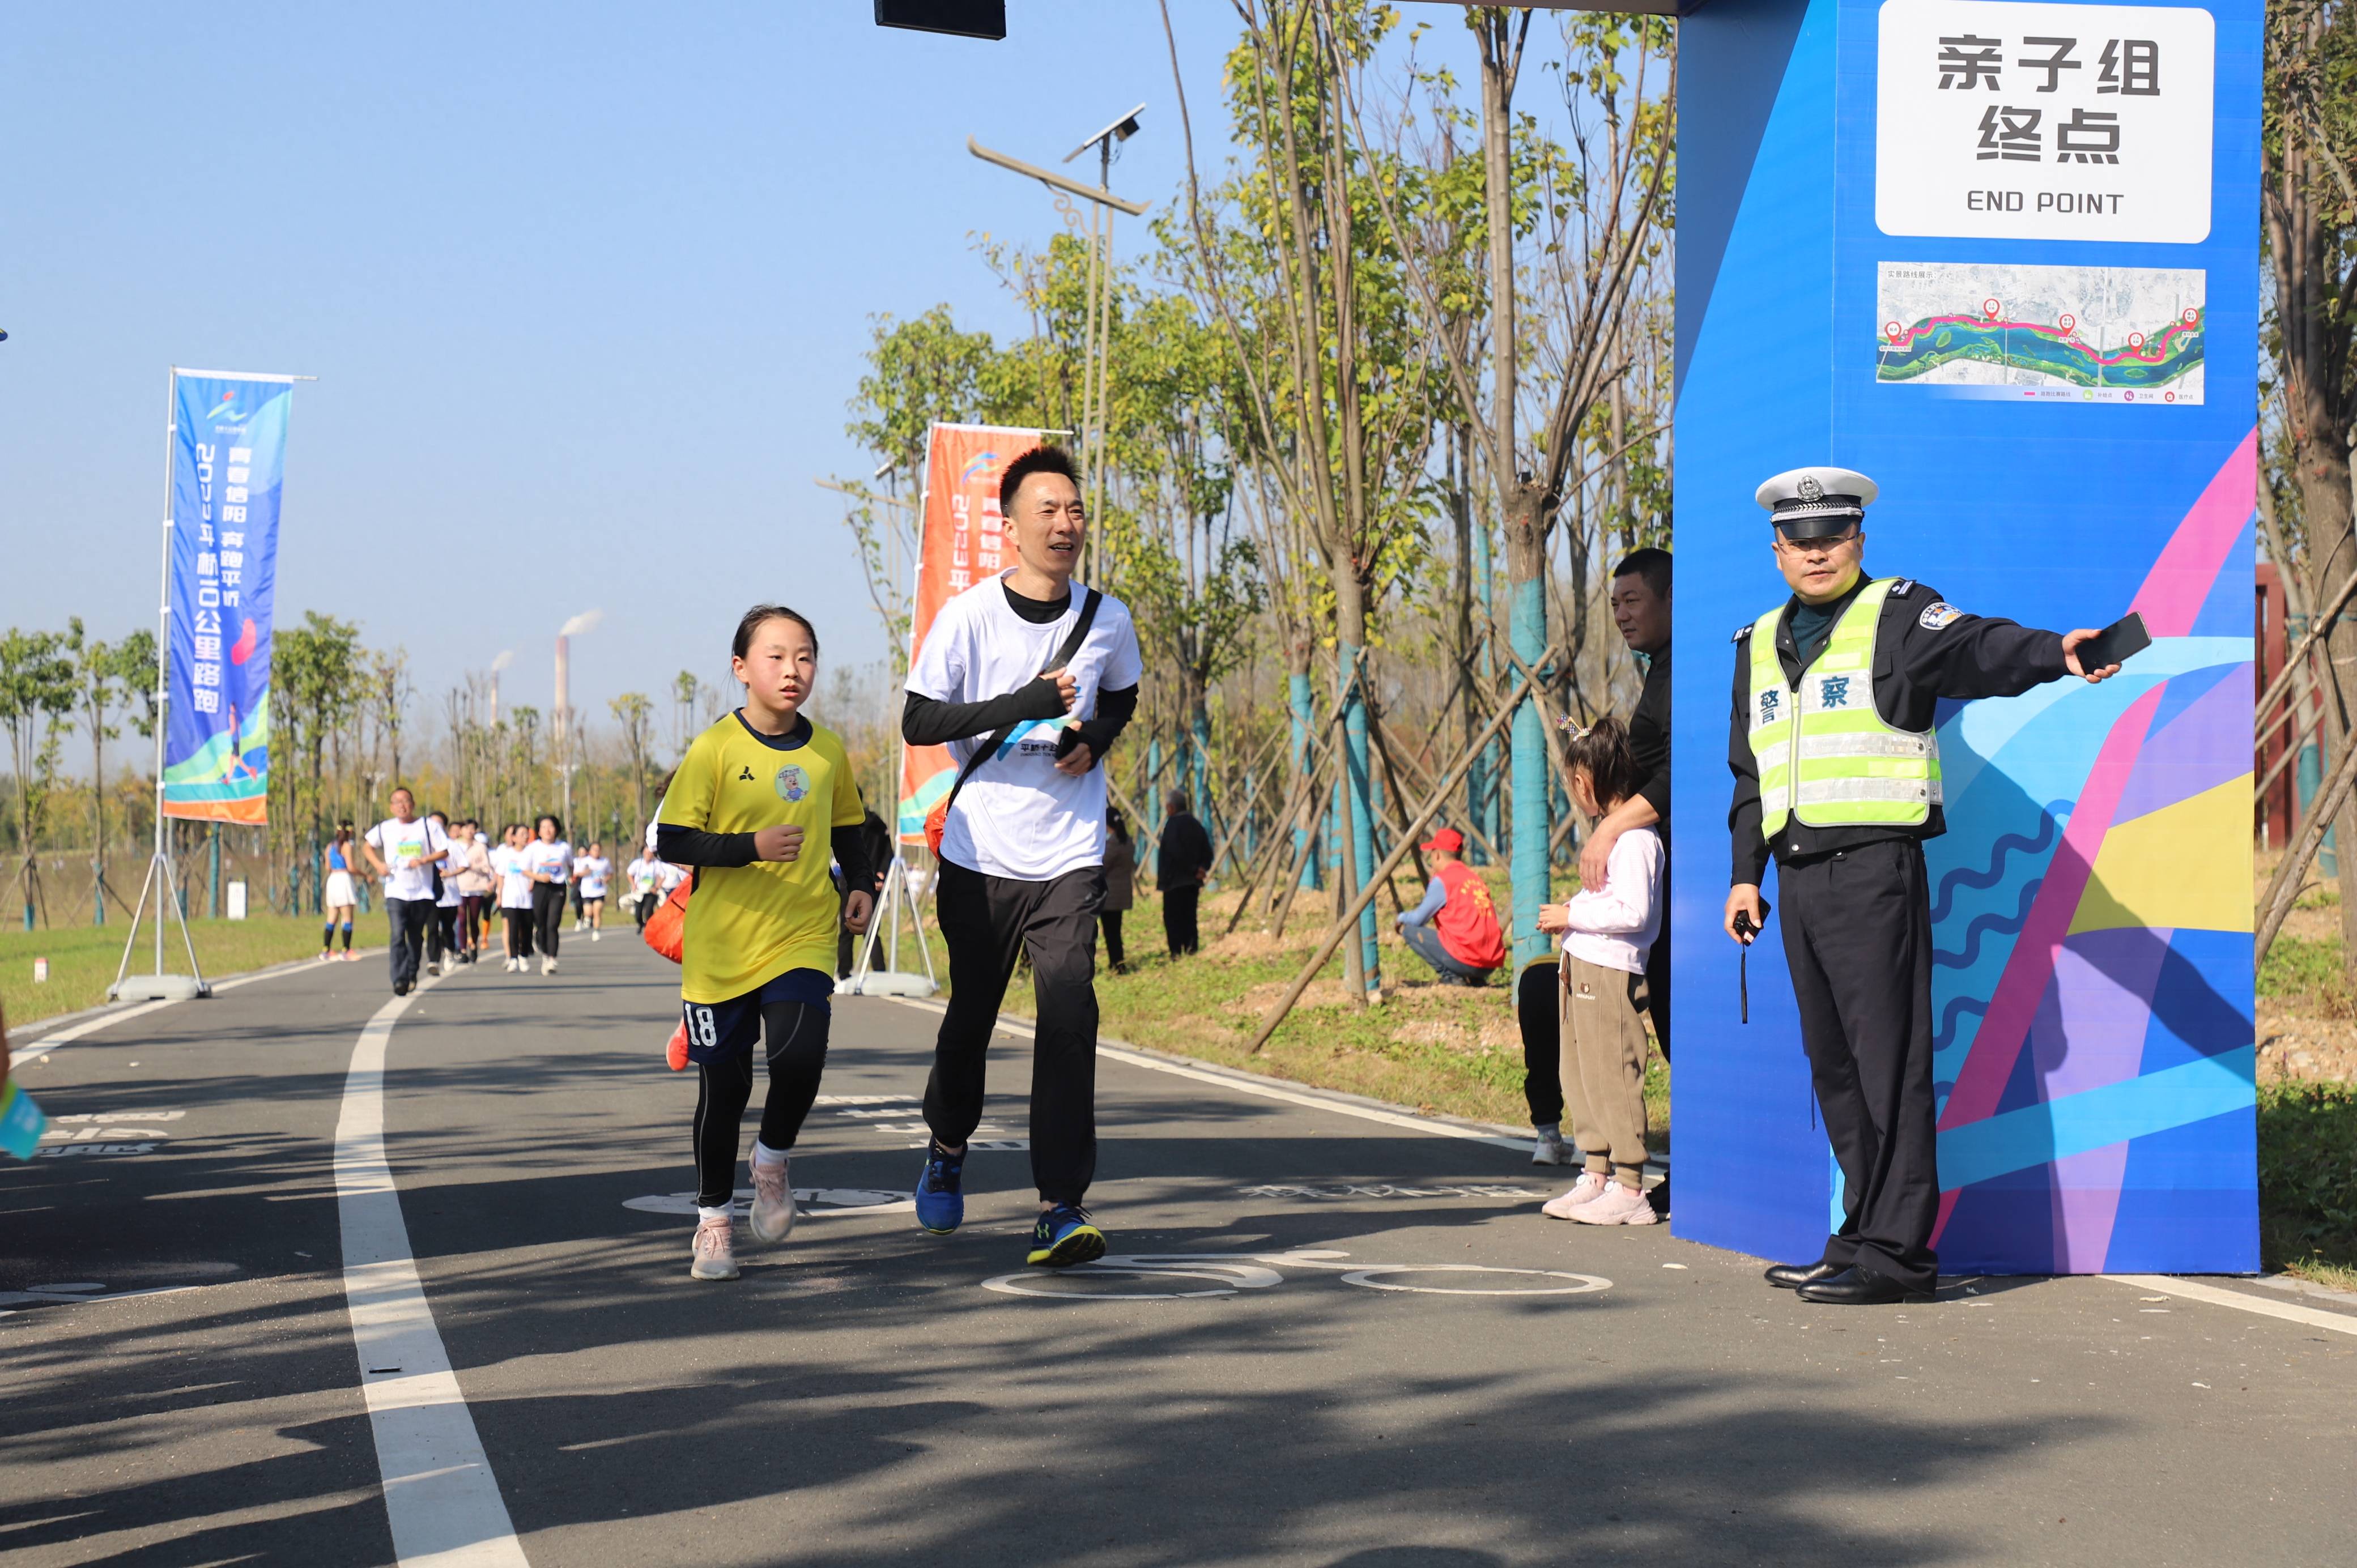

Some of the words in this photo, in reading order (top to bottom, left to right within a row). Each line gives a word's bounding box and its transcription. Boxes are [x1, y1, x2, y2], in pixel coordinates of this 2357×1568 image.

[1938, 34, 2160, 96] 亲子组
[1977, 105, 2120, 164] 终点
[1967, 190, 2023, 212] END
[2037, 193, 2124, 214] POINT
[1760, 676, 1849, 725] 警察
[685, 1003, 717, 1047] 18
